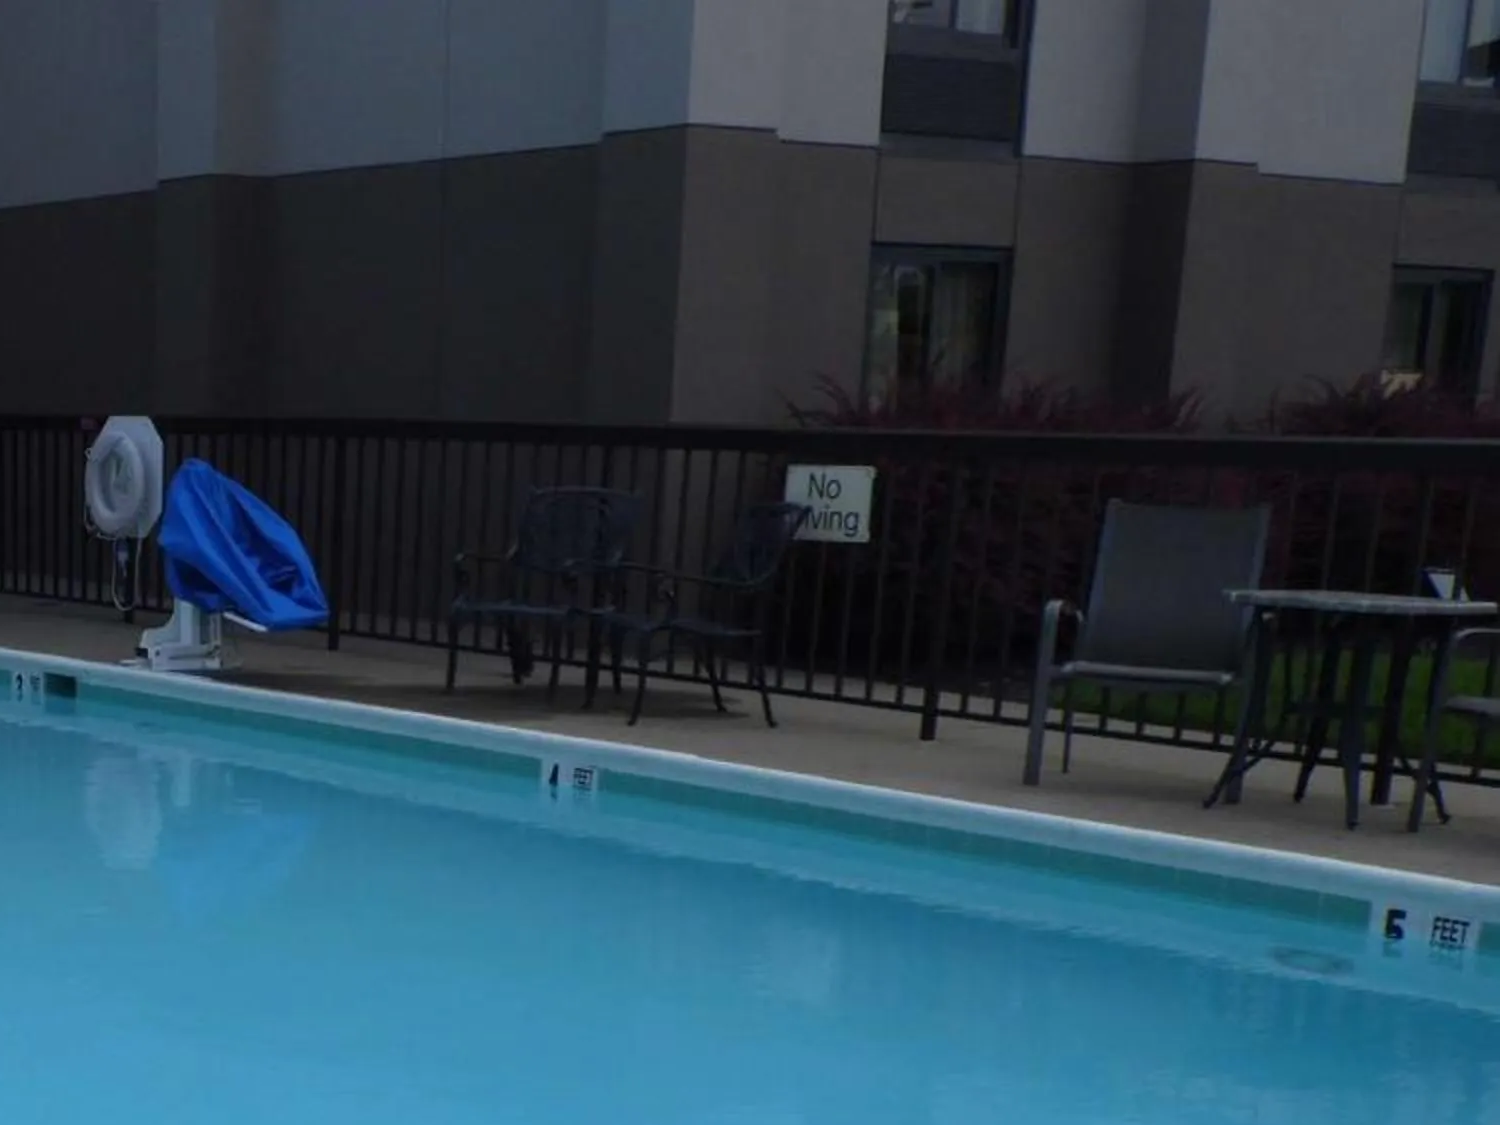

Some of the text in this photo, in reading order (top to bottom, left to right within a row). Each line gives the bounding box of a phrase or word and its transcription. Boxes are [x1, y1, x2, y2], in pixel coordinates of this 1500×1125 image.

[807, 472, 842, 500] No
[802, 503, 860, 538] iving
[1384, 908, 1471, 945] 5 FEET
